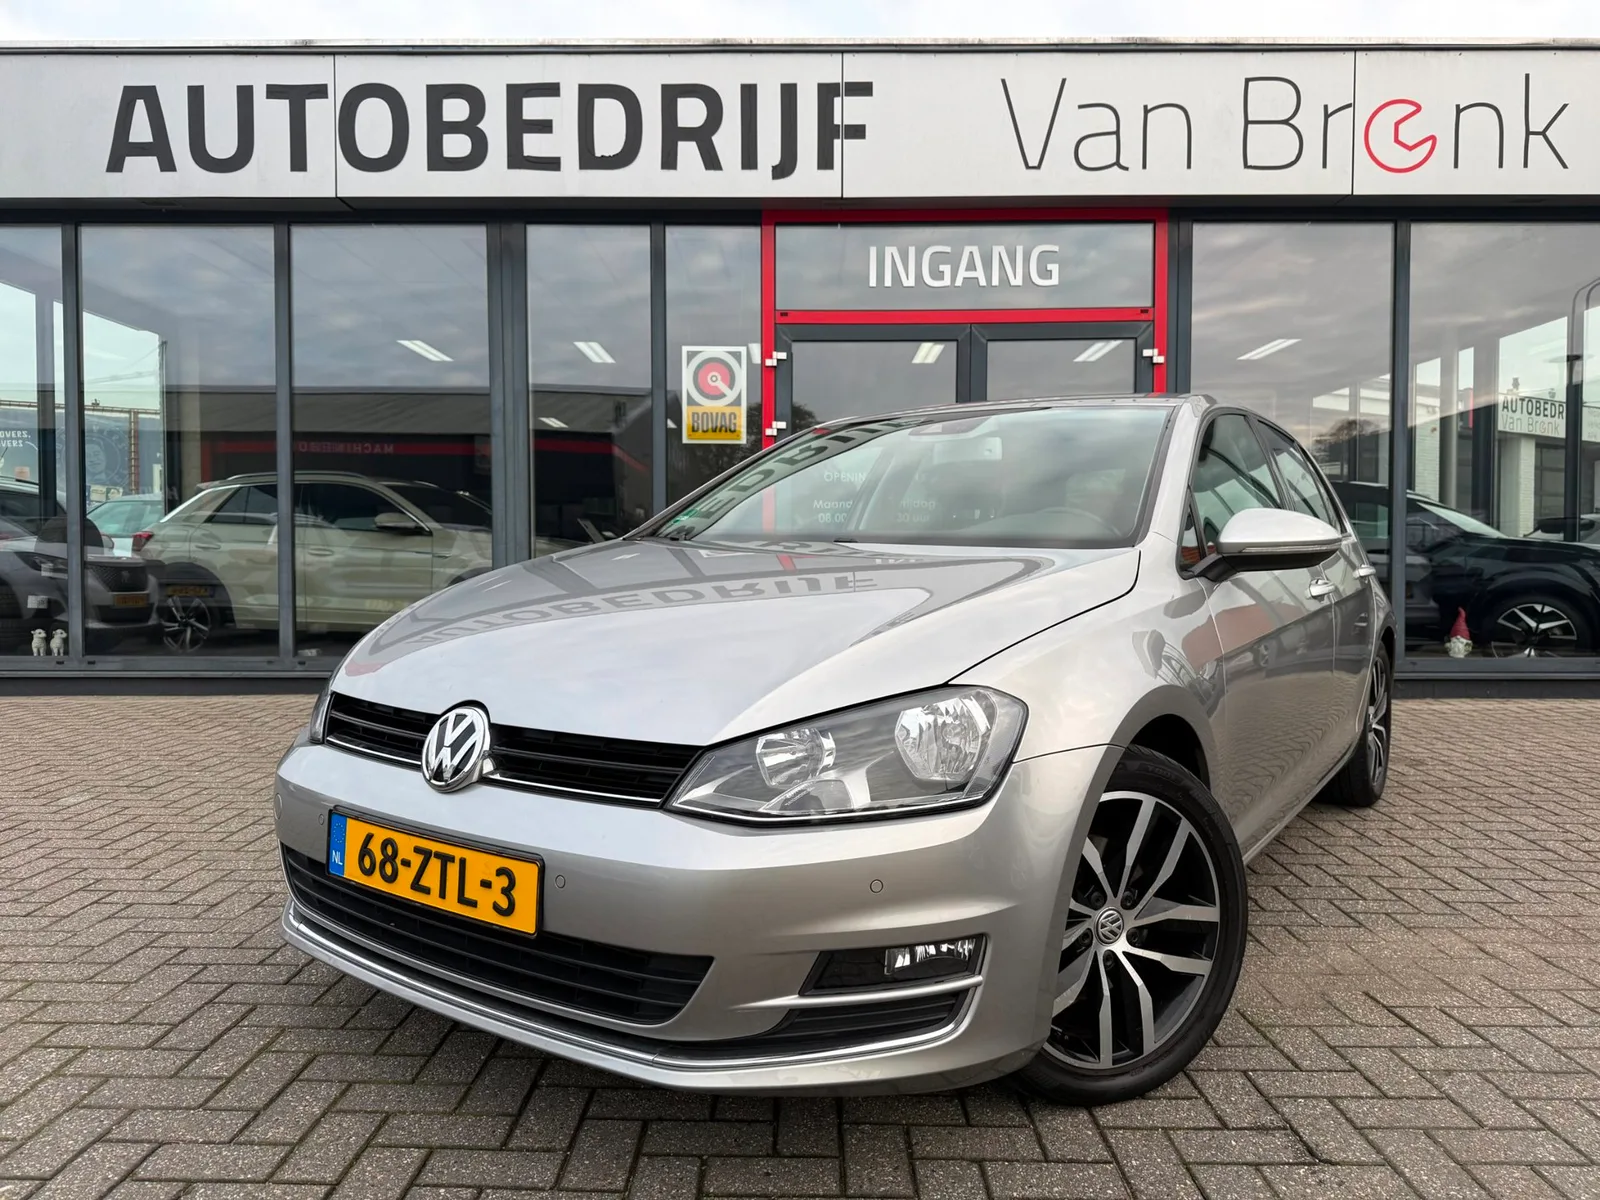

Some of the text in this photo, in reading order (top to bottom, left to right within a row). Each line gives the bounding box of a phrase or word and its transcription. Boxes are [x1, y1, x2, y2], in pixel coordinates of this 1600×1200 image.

[106, 81, 874, 181] AUTOBEDRIJF
[1000, 78, 1193, 171] Van
[867, 244, 1061, 288] INGANG
[691, 413, 738, 435] BOVAG
[332, 832, 517, 917] NL 68-ZTL-3
